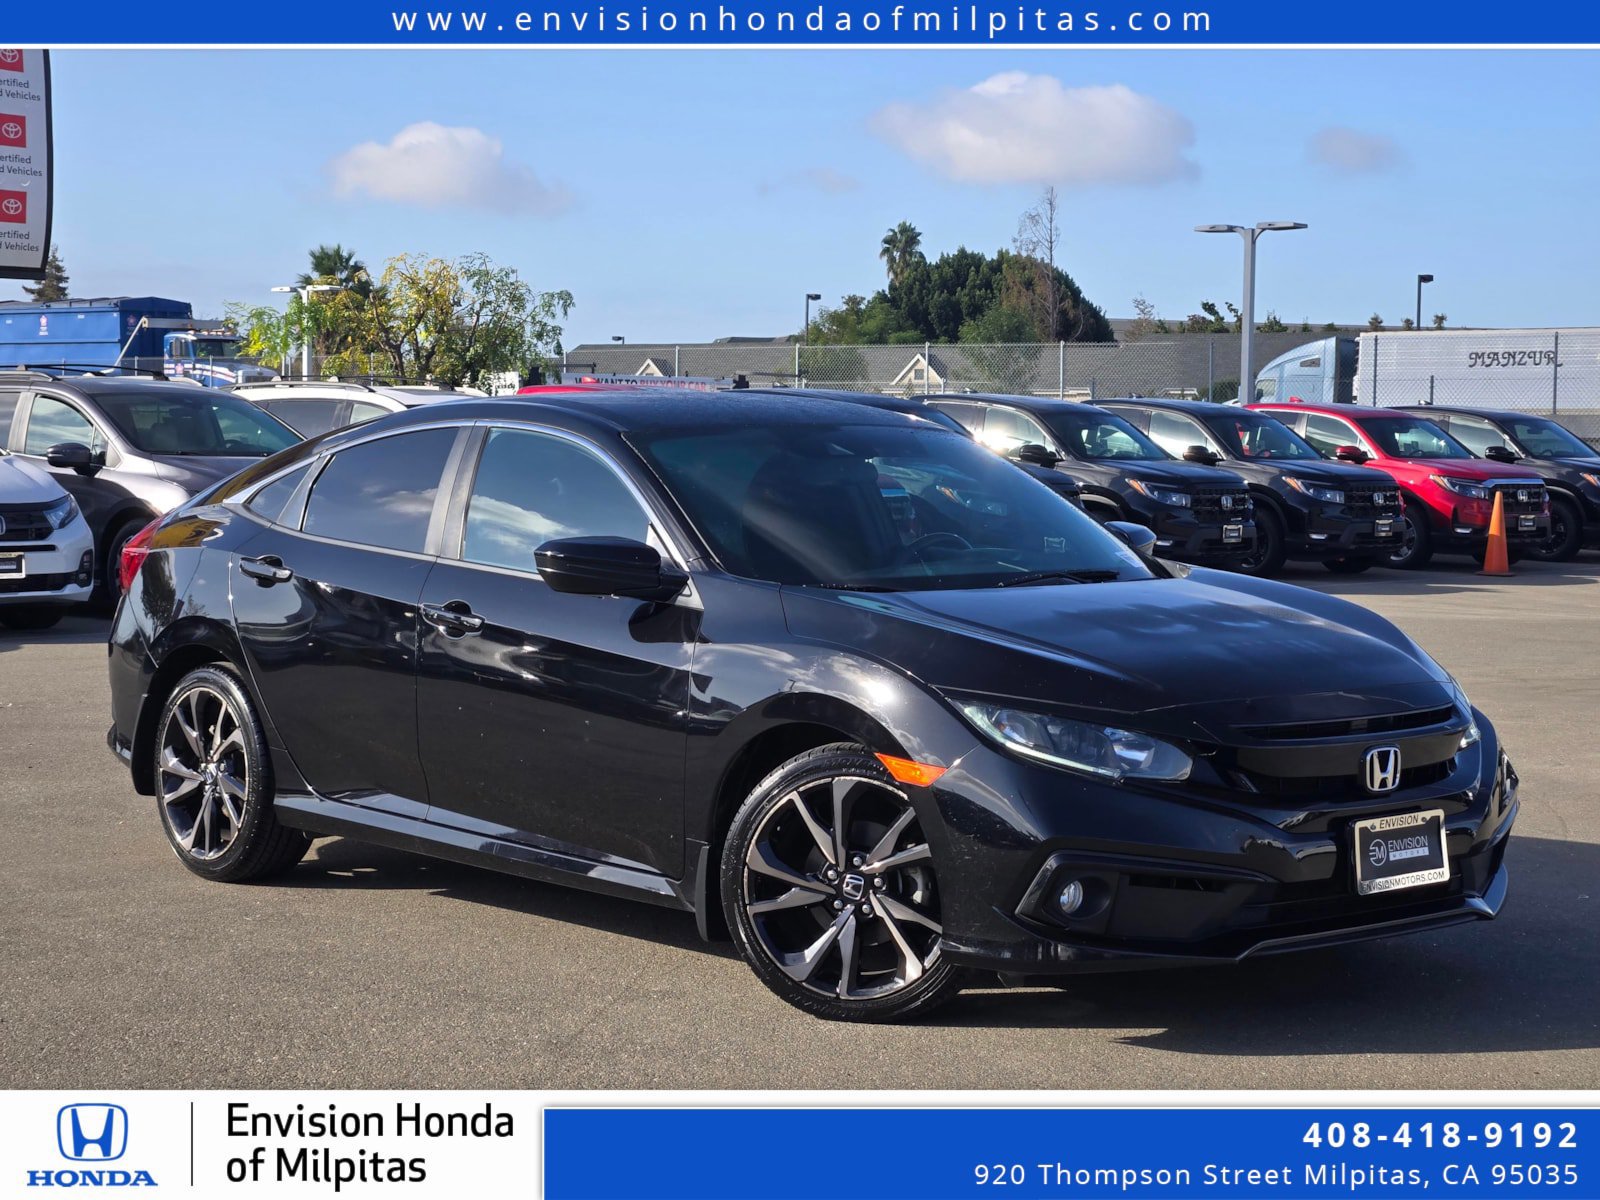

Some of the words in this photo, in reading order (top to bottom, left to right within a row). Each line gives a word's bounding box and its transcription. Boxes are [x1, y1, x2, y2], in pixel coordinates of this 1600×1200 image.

[0, 78, 29, 89] ertified
[5, 89, 41, 101] Vehicles
[0, 154, 32, 164] ertified
[7, 165, 43, 177] Vehicles
[0, 229, 30, 240] ertified
[5, 241, 39, 252] Vehicles
[1468, 350, 1563, 368] MANZUR
[1379, 814, 1419, 829] ENVISION
[1387, 835, 1428, 852] ENVISION
